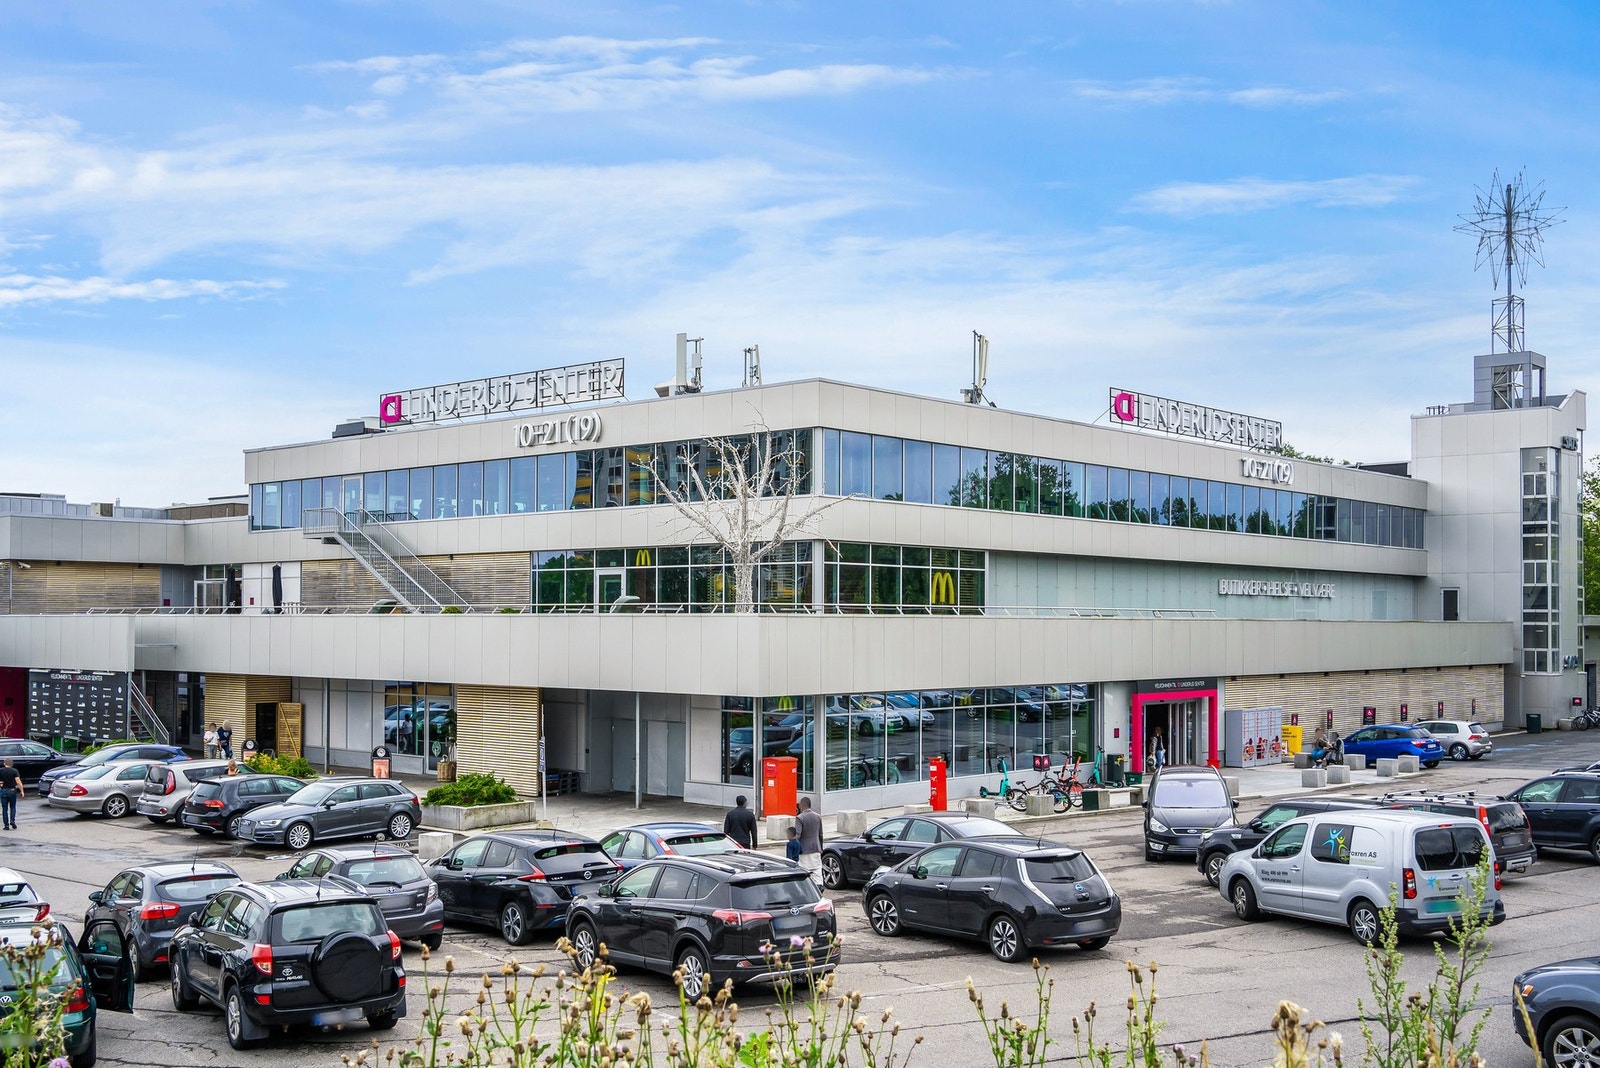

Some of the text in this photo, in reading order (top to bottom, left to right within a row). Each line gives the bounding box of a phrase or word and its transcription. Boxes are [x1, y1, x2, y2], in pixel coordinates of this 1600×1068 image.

[407, 378, 517, 421] LINDERUD
[523, 363, 622, 406] SENTER
[1139, 395, 1283, 449] LINDERUD SENTER
[1219, 579, 1262, 595] BUTIKKER
[1268, 581, 1294, 596] HELSE
[1368, 851, 1378, 859] AS
